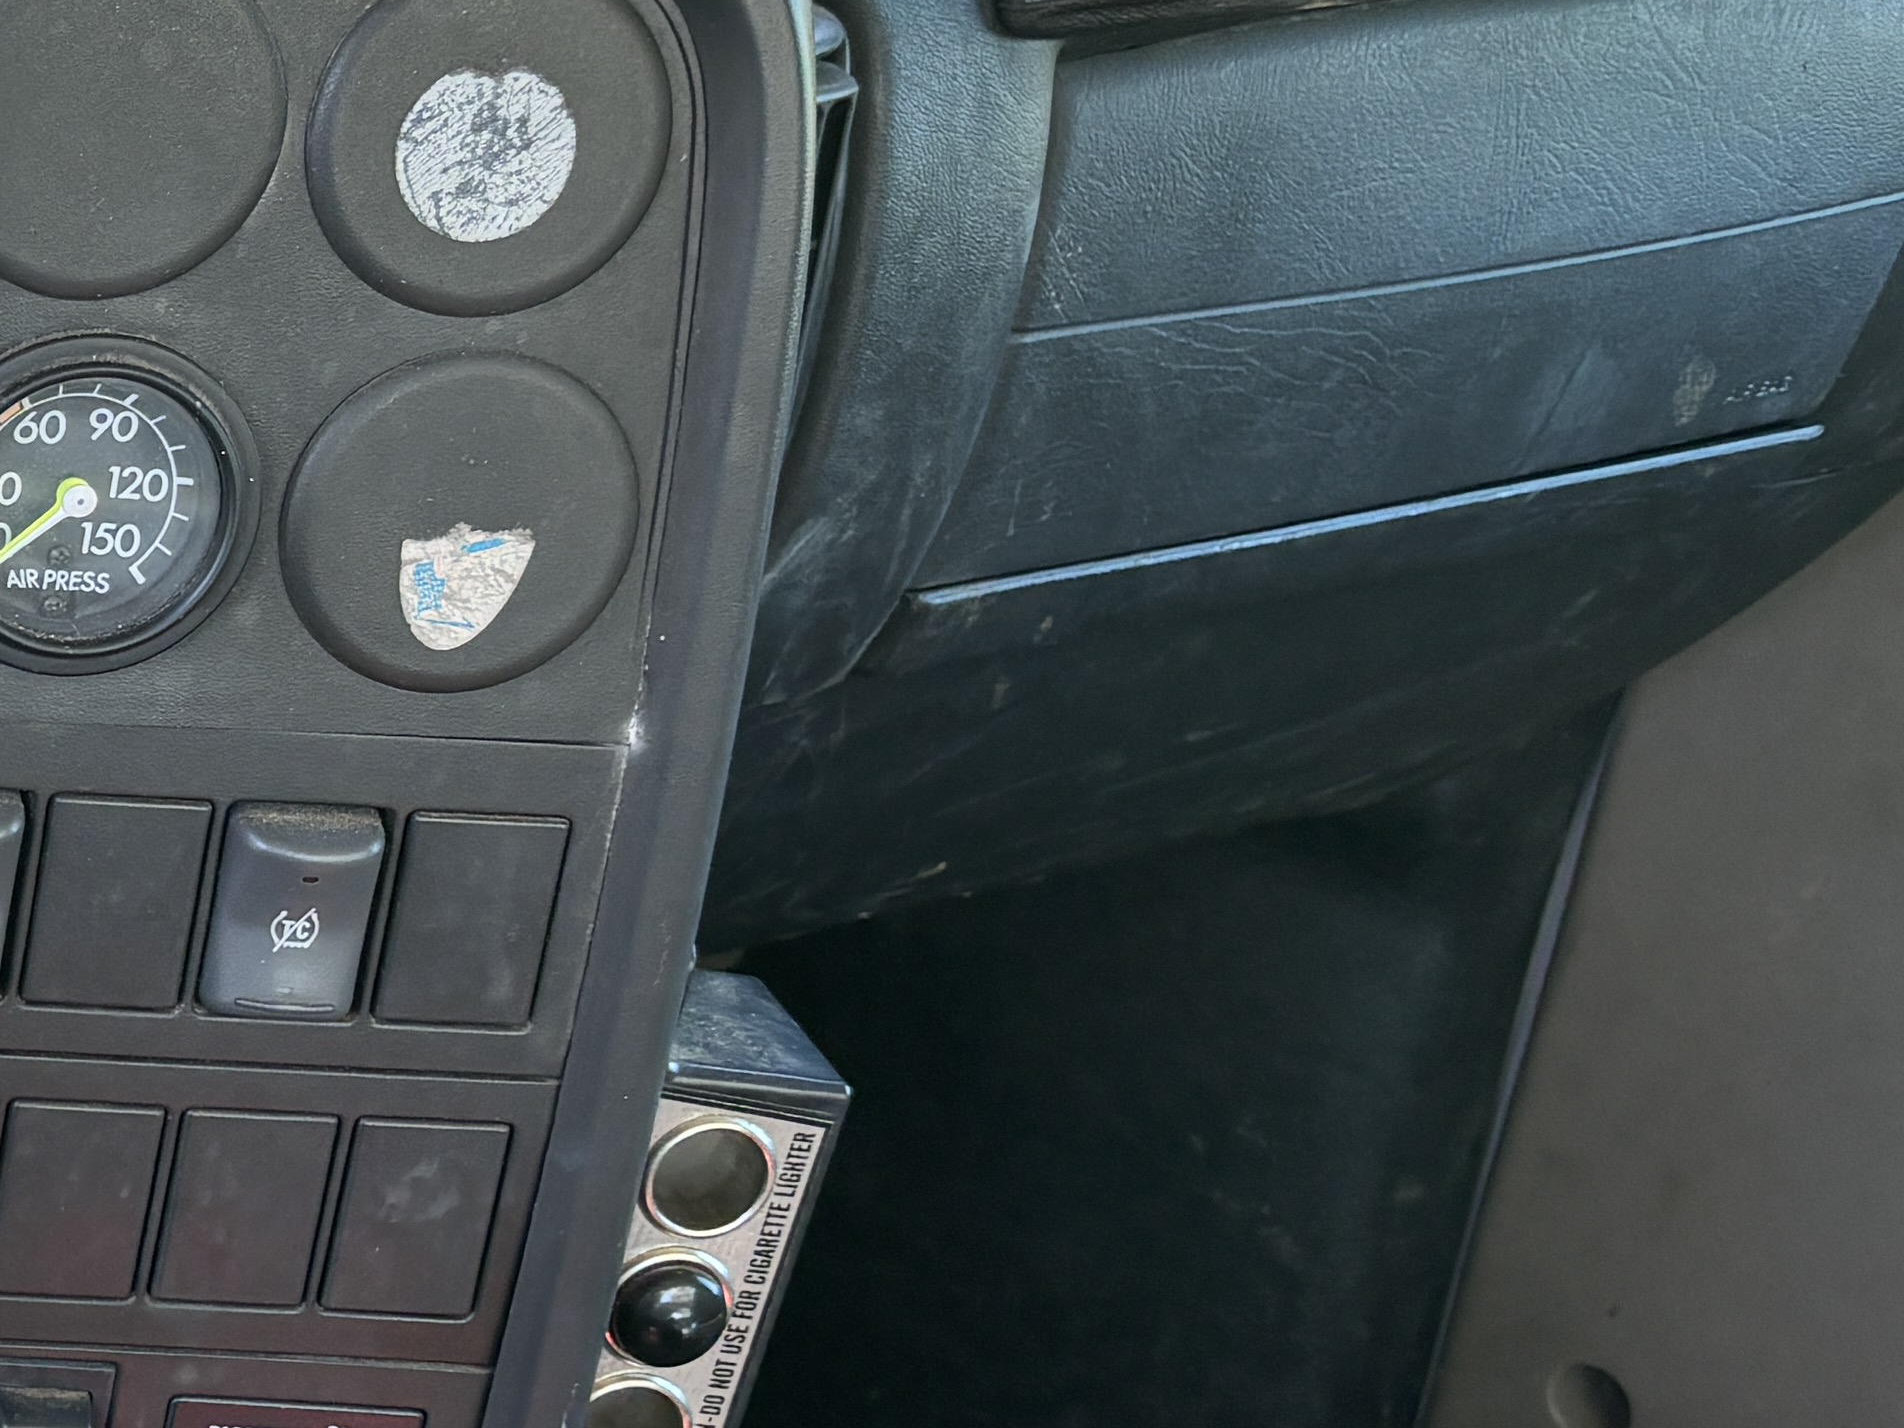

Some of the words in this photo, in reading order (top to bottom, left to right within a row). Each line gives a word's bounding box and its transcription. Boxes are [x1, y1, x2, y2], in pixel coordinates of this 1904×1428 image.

[13, 409, 67, 445] 60
[89, 408, 139, 443] 90
[108, 465, 169, 502] 120
[80, 522, 141, 558] 150
[6, 568, 40, 589] AIR
[42, 570, 110, 594] PRESS
[773, 1132, 817, 1198] LIGHTER
[743, 1201, 791, 1285] CIGARETTE
[732, 1290, 761, 1320] FOR
[720, 1323, 749, 1354] USE
[708, 1358, 737, 1389] NOT
